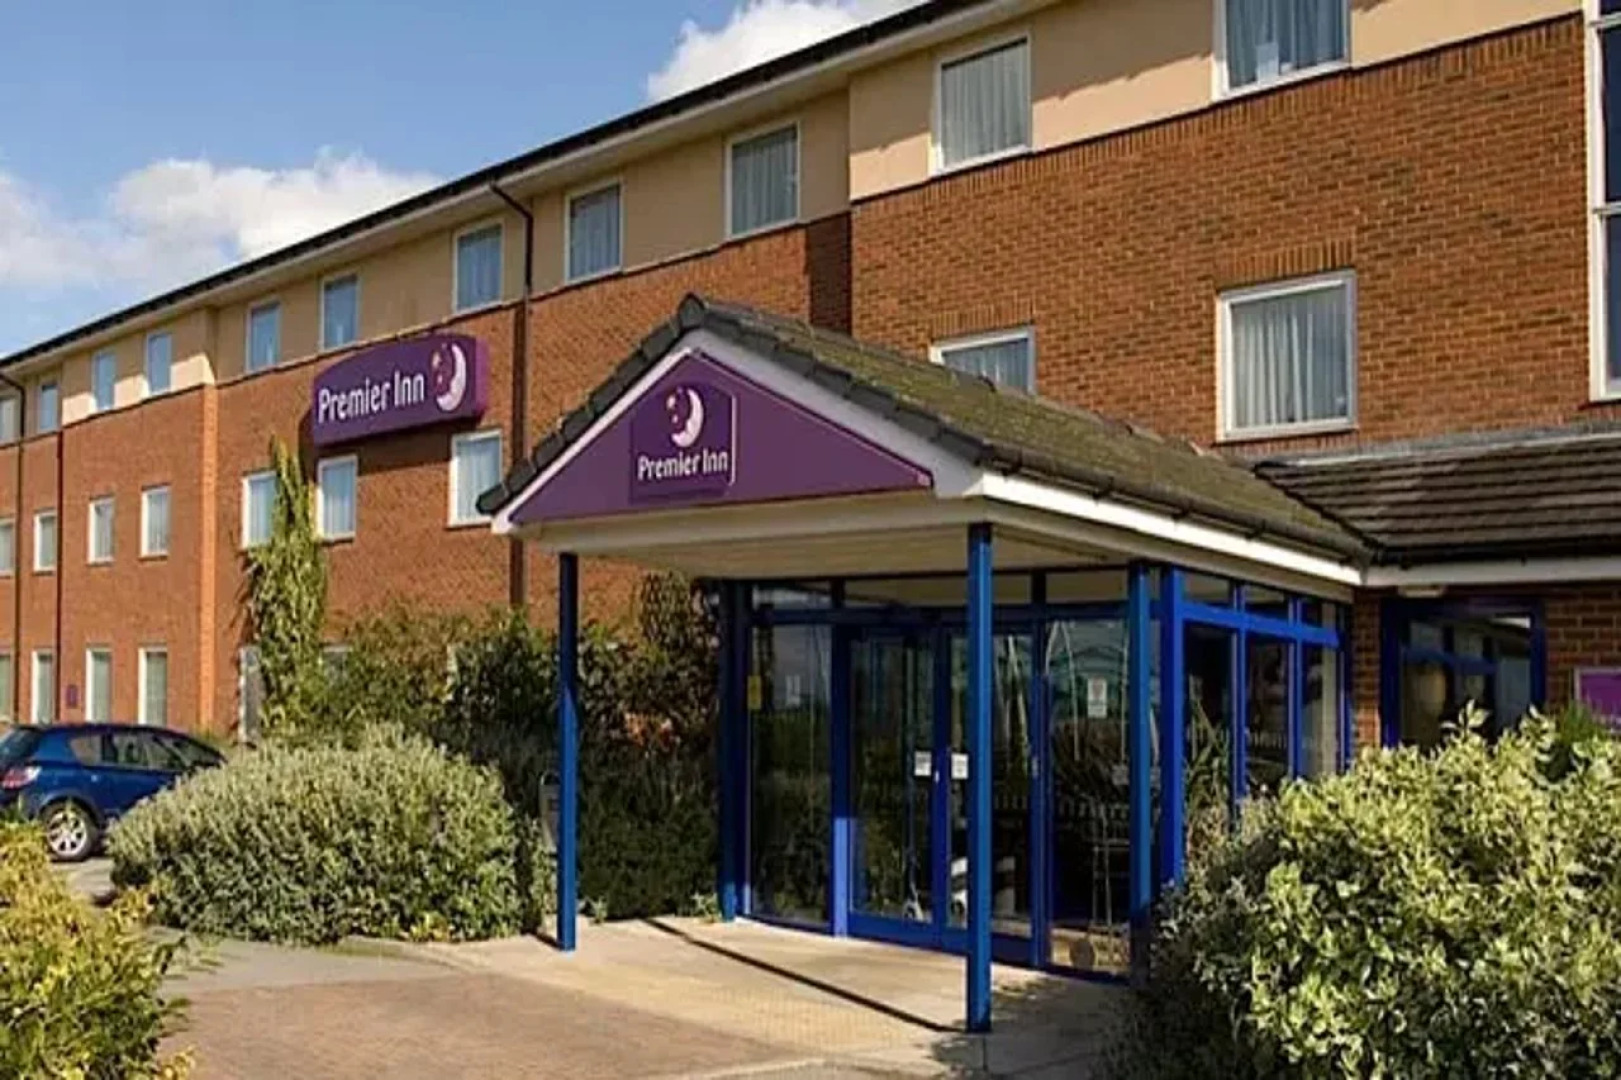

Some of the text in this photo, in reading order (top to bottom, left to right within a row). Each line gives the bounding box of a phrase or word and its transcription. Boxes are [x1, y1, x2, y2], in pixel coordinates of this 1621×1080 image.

[318, 370, 425, 424] Premier Inn
[637, 448, 728, 480] Premier Inn
